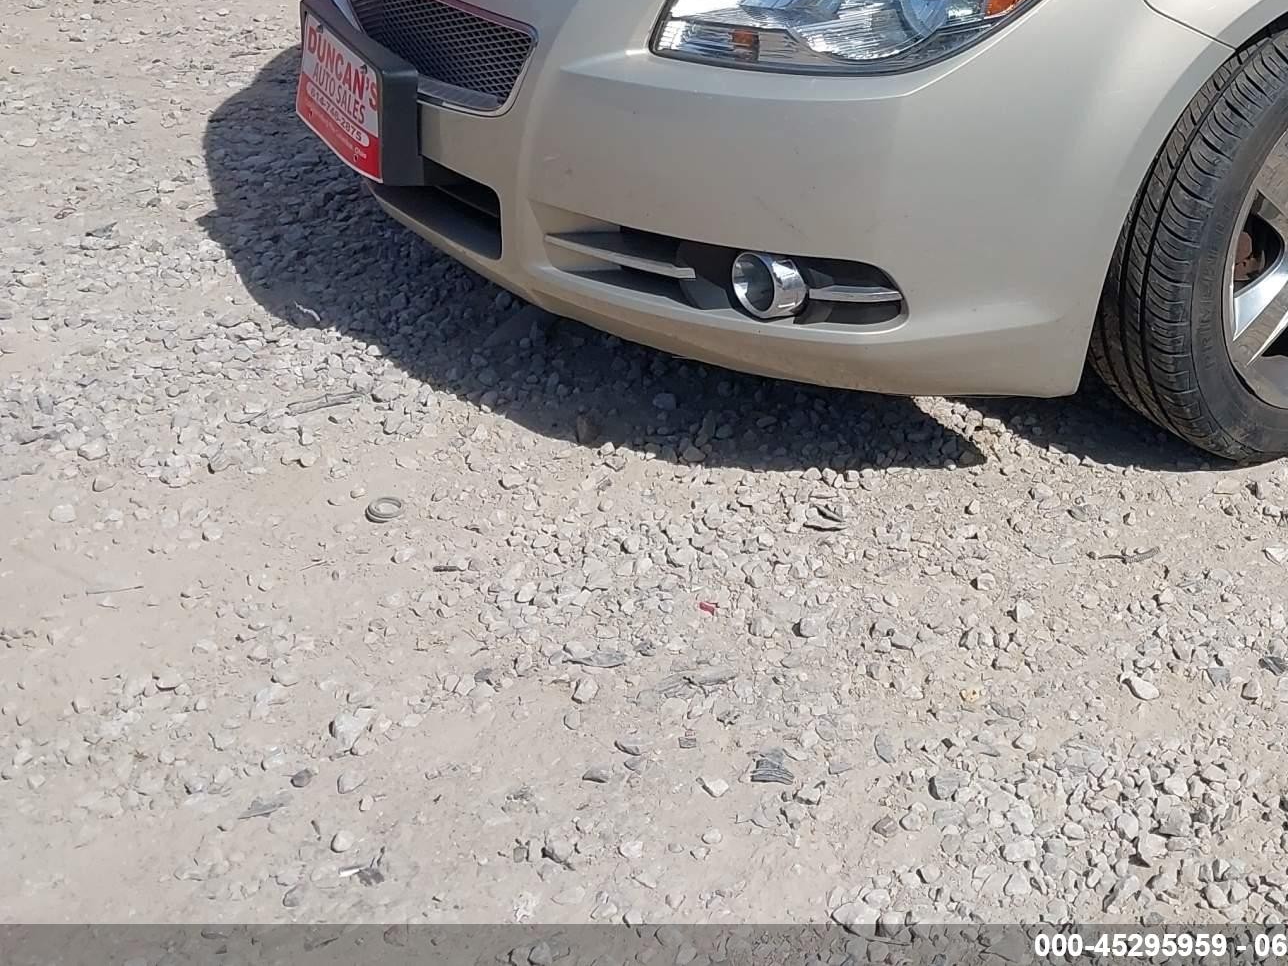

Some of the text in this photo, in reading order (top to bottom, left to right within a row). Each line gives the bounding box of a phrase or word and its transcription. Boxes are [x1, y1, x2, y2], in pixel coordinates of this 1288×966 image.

[307, 25, 378, 111] DUNCAN'S
[312, 62, 366, 125] AUTO SALES
